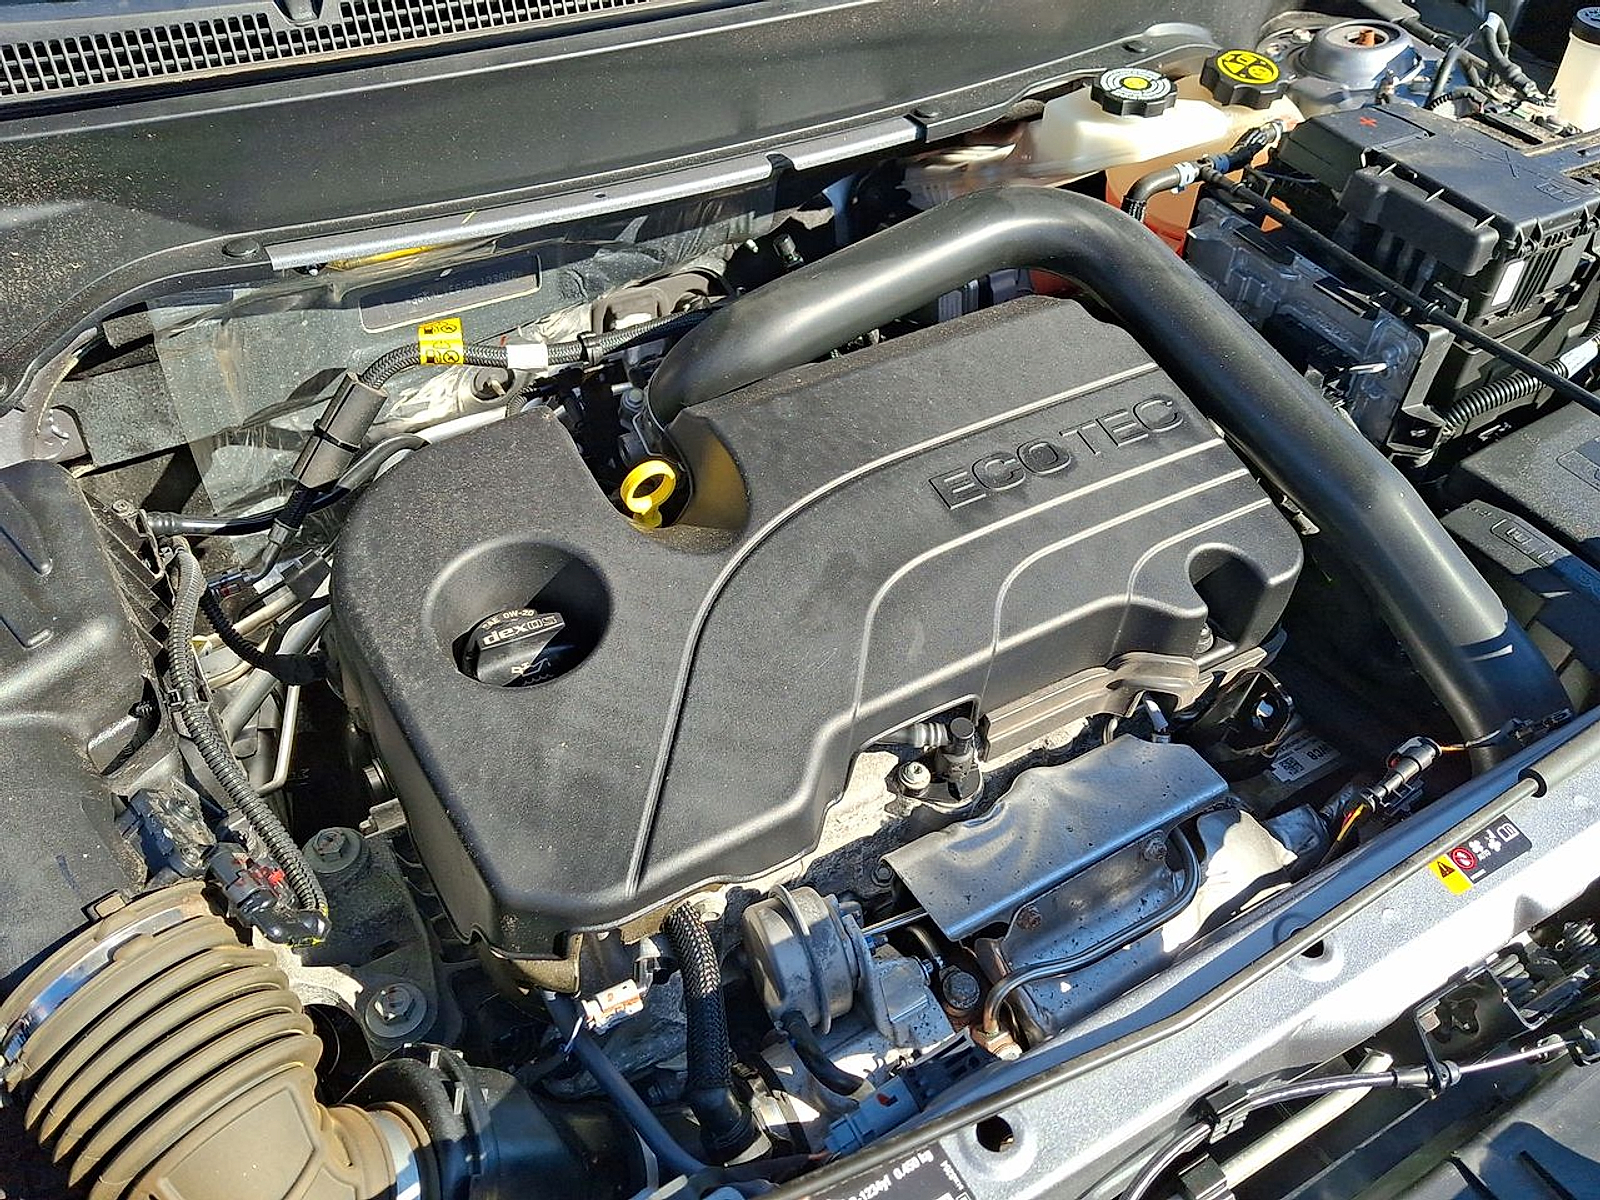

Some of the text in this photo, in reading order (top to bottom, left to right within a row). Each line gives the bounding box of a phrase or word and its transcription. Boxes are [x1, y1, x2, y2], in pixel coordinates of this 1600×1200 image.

[928, 394, 1183, 509] ECOTEC
[482, 609, 535, 630] SAE 0W-20
[483, 615, 557, 645] dexos
